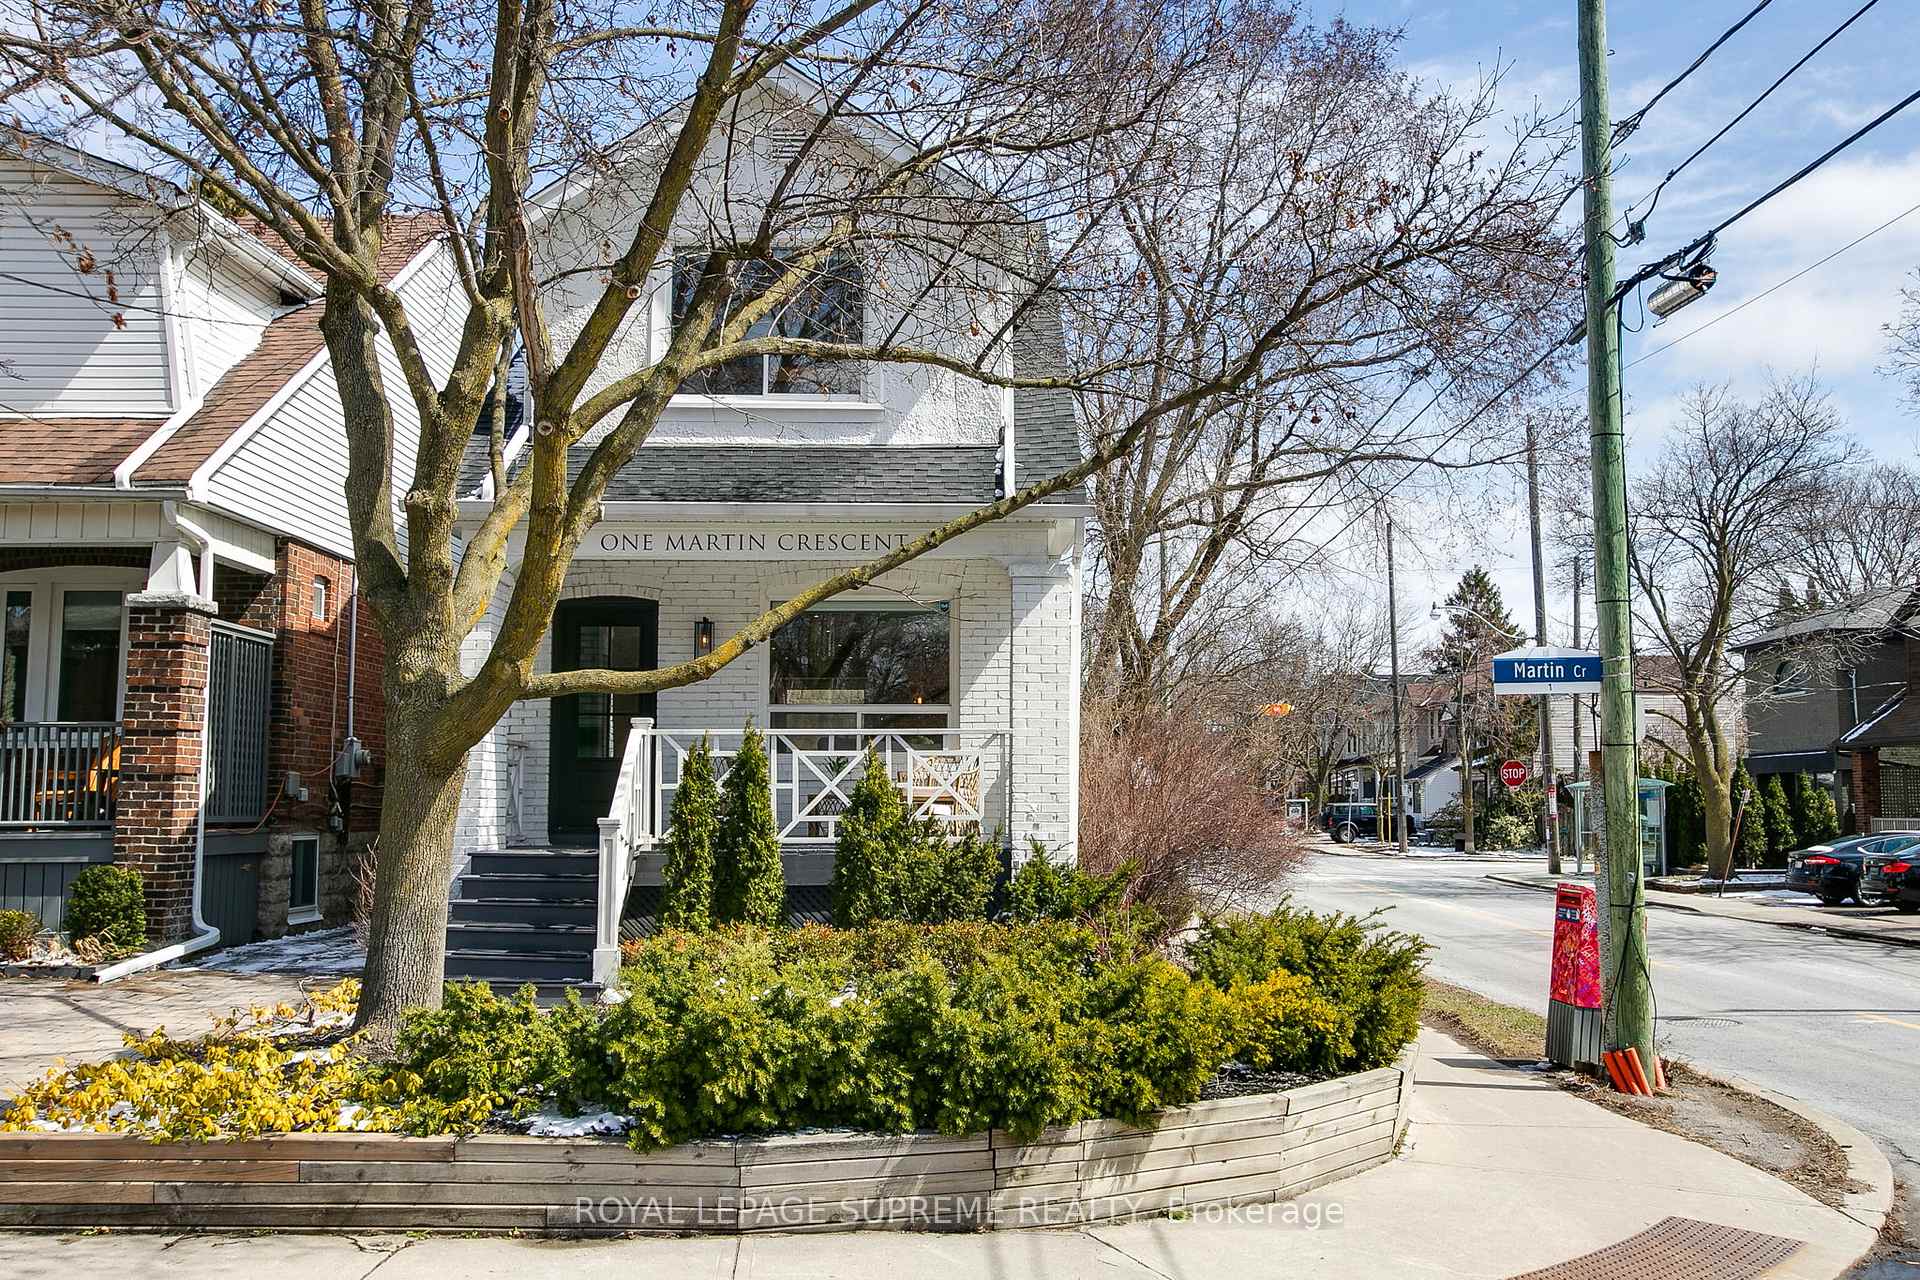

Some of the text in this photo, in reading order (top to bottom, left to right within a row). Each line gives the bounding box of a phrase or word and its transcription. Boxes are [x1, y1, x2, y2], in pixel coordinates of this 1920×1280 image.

[600, 533, 909, 551] ONE MARTIN CRESCENT
[1514, 662, 1587, 679] Martin Cr
[1502, 768, 1525, 780] STOP
